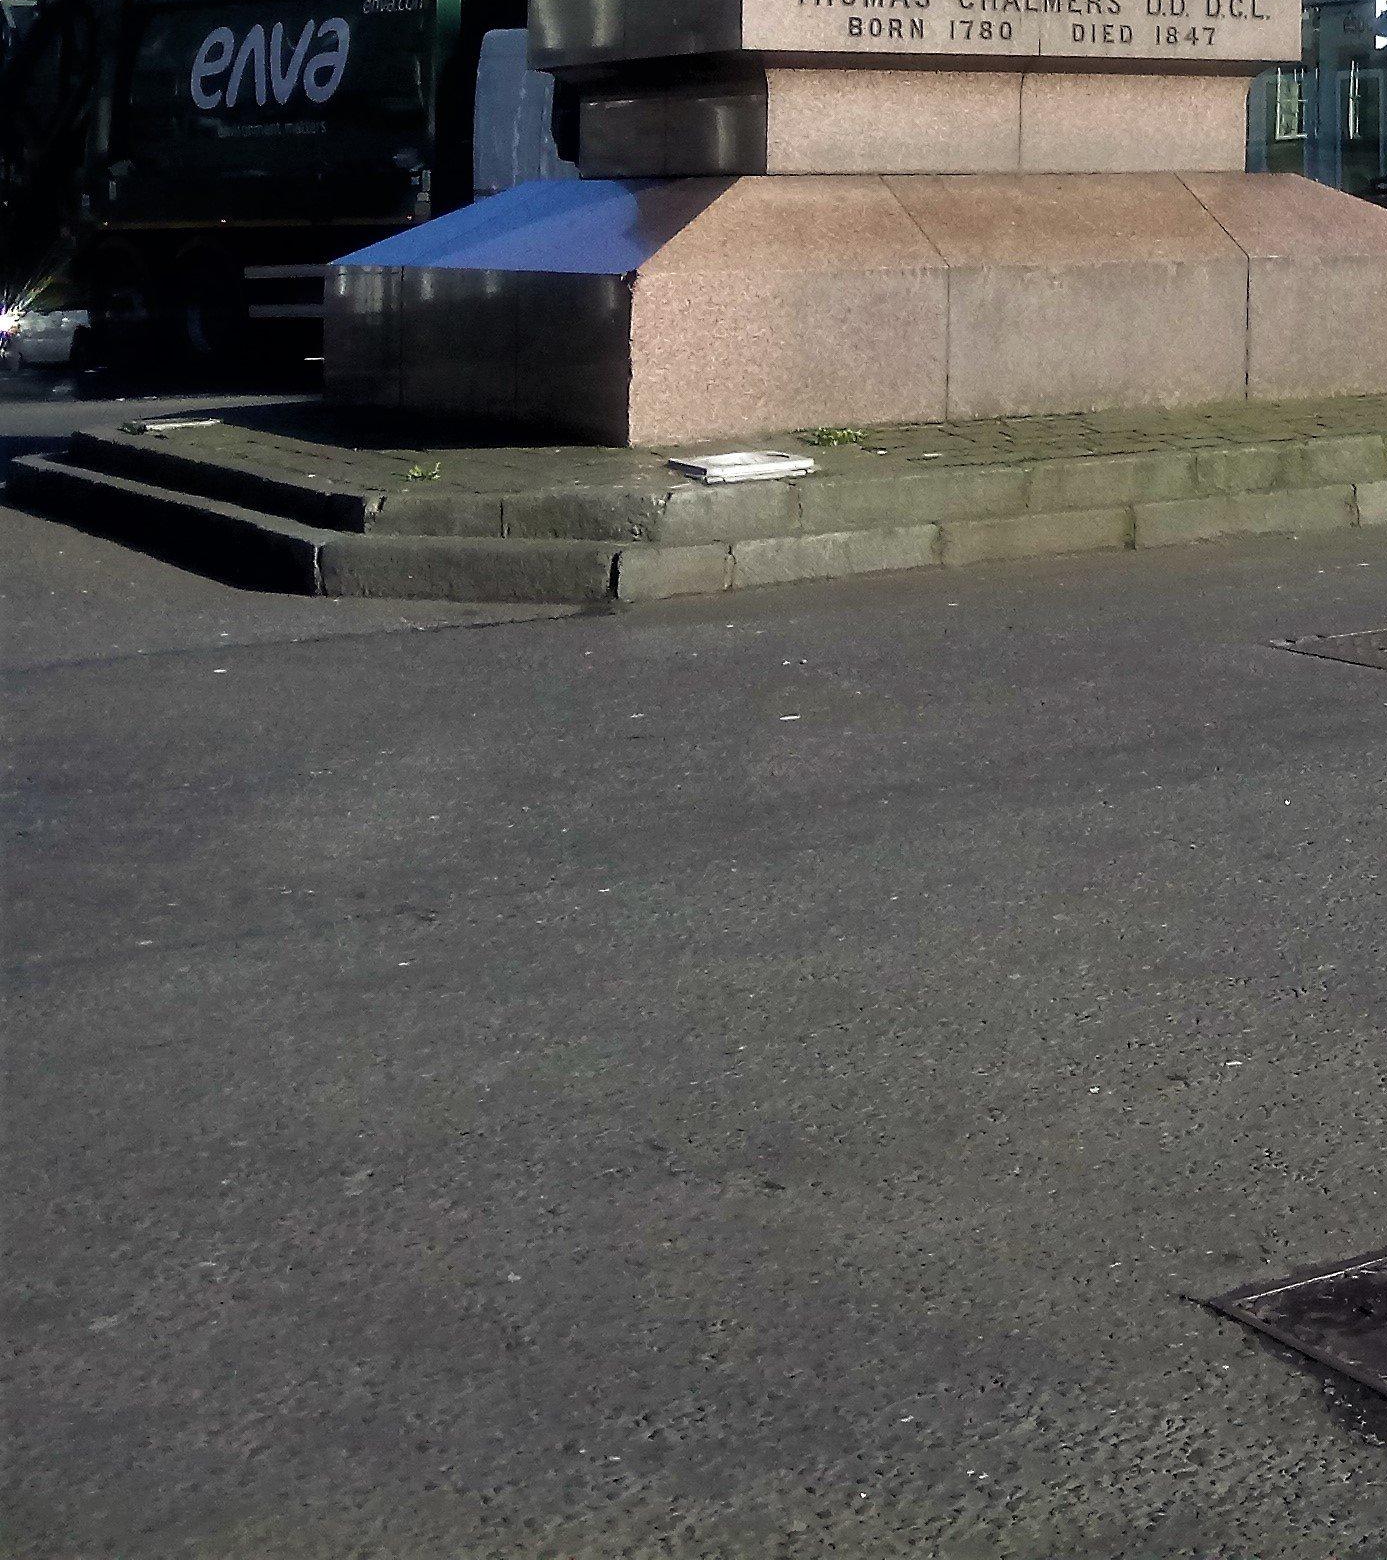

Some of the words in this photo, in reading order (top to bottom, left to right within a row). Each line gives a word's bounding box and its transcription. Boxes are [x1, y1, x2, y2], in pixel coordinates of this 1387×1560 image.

[848, 16, 925, 40] BORN
[949, 19, 1013, 40] 1780
[1071, 22, 1134, 44] DIED
[1155, 24, 1217, 46] 1847
[190, 16, 351, 110] enva
